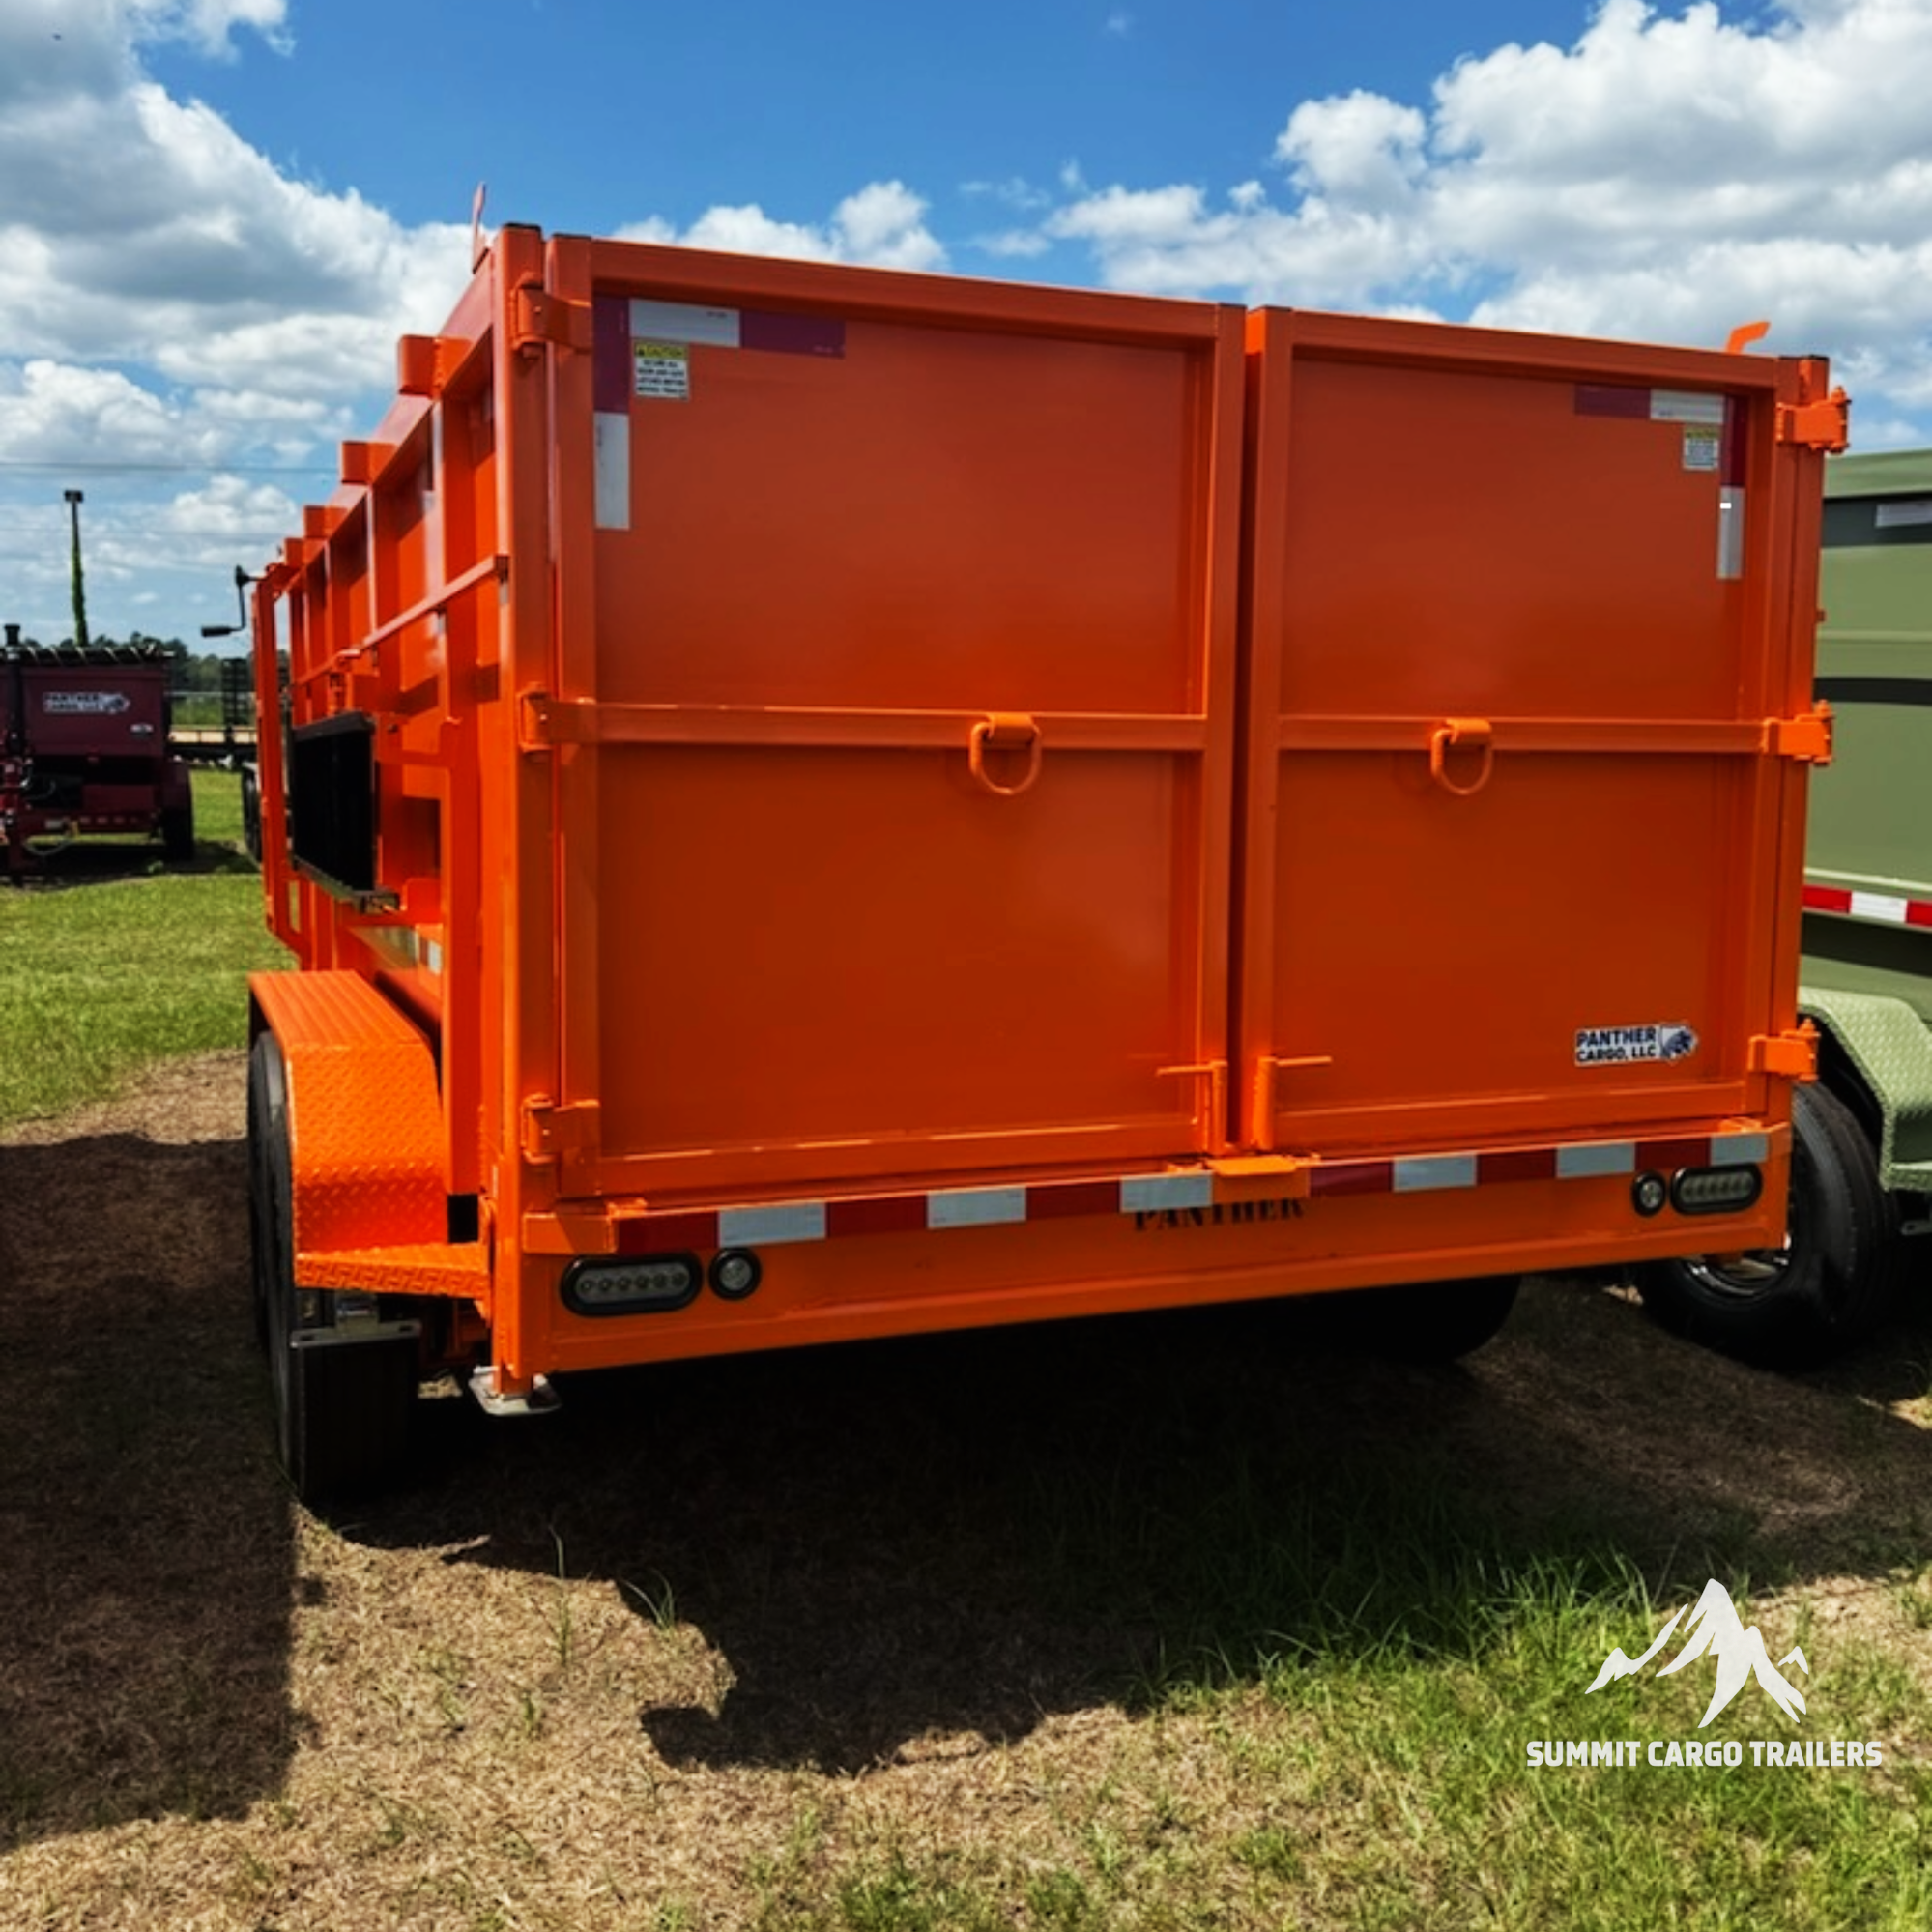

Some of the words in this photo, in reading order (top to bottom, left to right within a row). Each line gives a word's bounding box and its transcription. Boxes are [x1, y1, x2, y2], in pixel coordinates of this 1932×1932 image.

[1576, 1026, 1657, 1047] PANTHER
[1630, 1043, 1657, 1058] LLC
[1135, 1197, 1305, 1231] PANTHER
